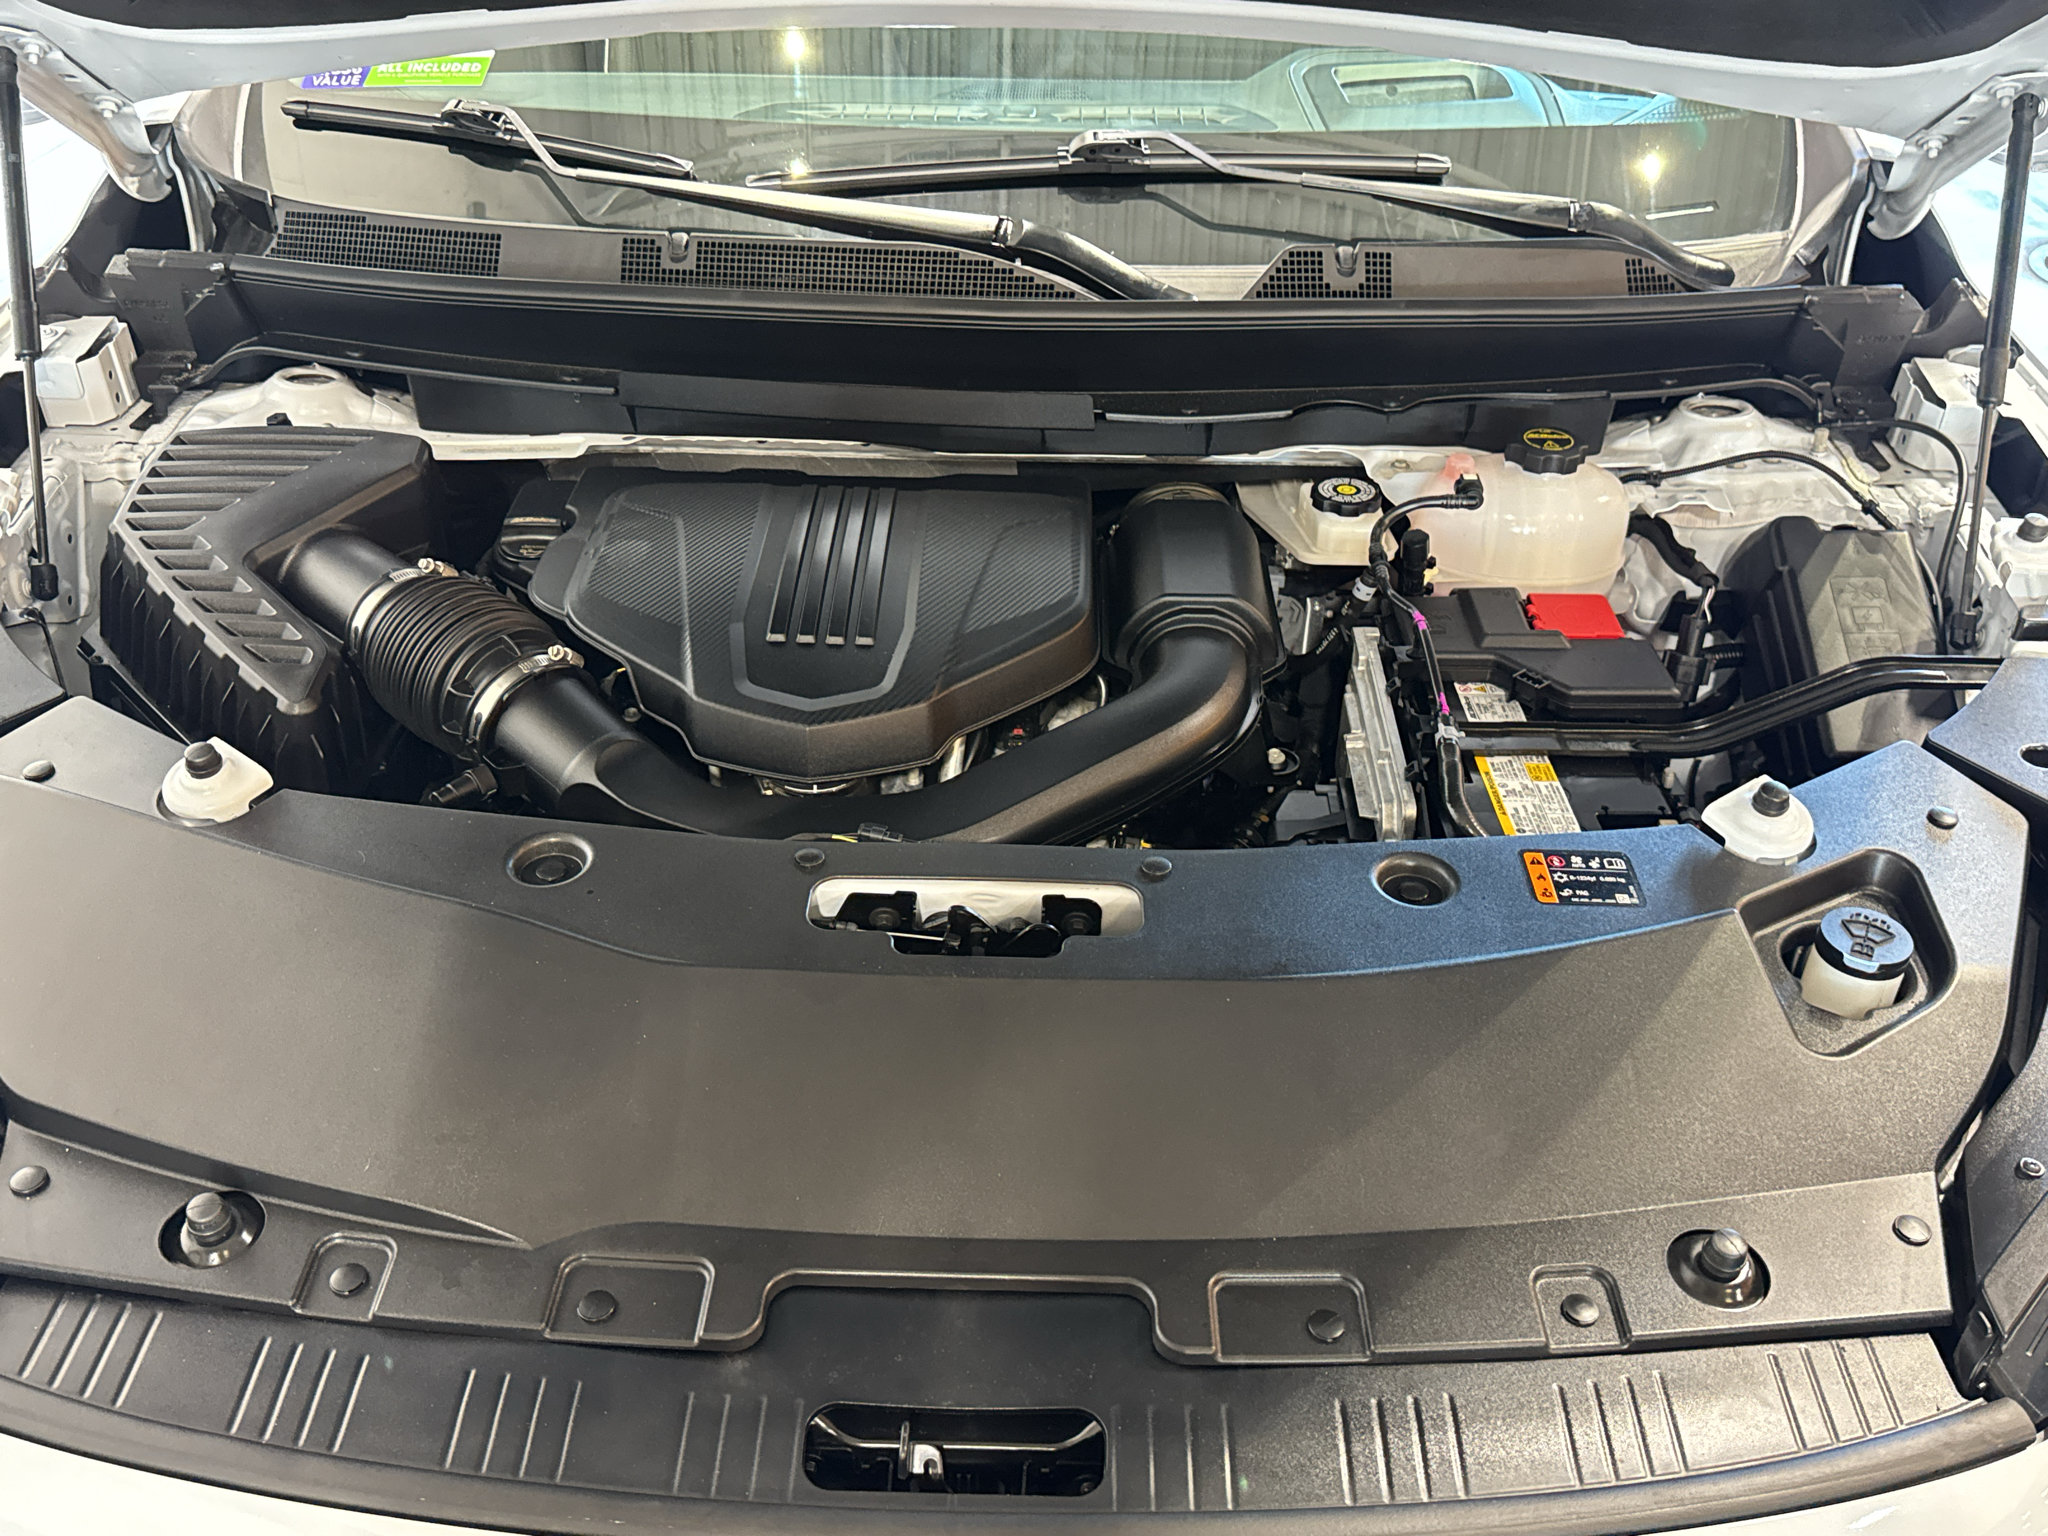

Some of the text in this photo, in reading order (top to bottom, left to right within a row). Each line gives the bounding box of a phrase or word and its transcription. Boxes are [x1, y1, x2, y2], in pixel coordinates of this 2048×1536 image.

[377, 62, 482, 72] ALL INCLUDED
[312, 75, 362, 86] VALUE
